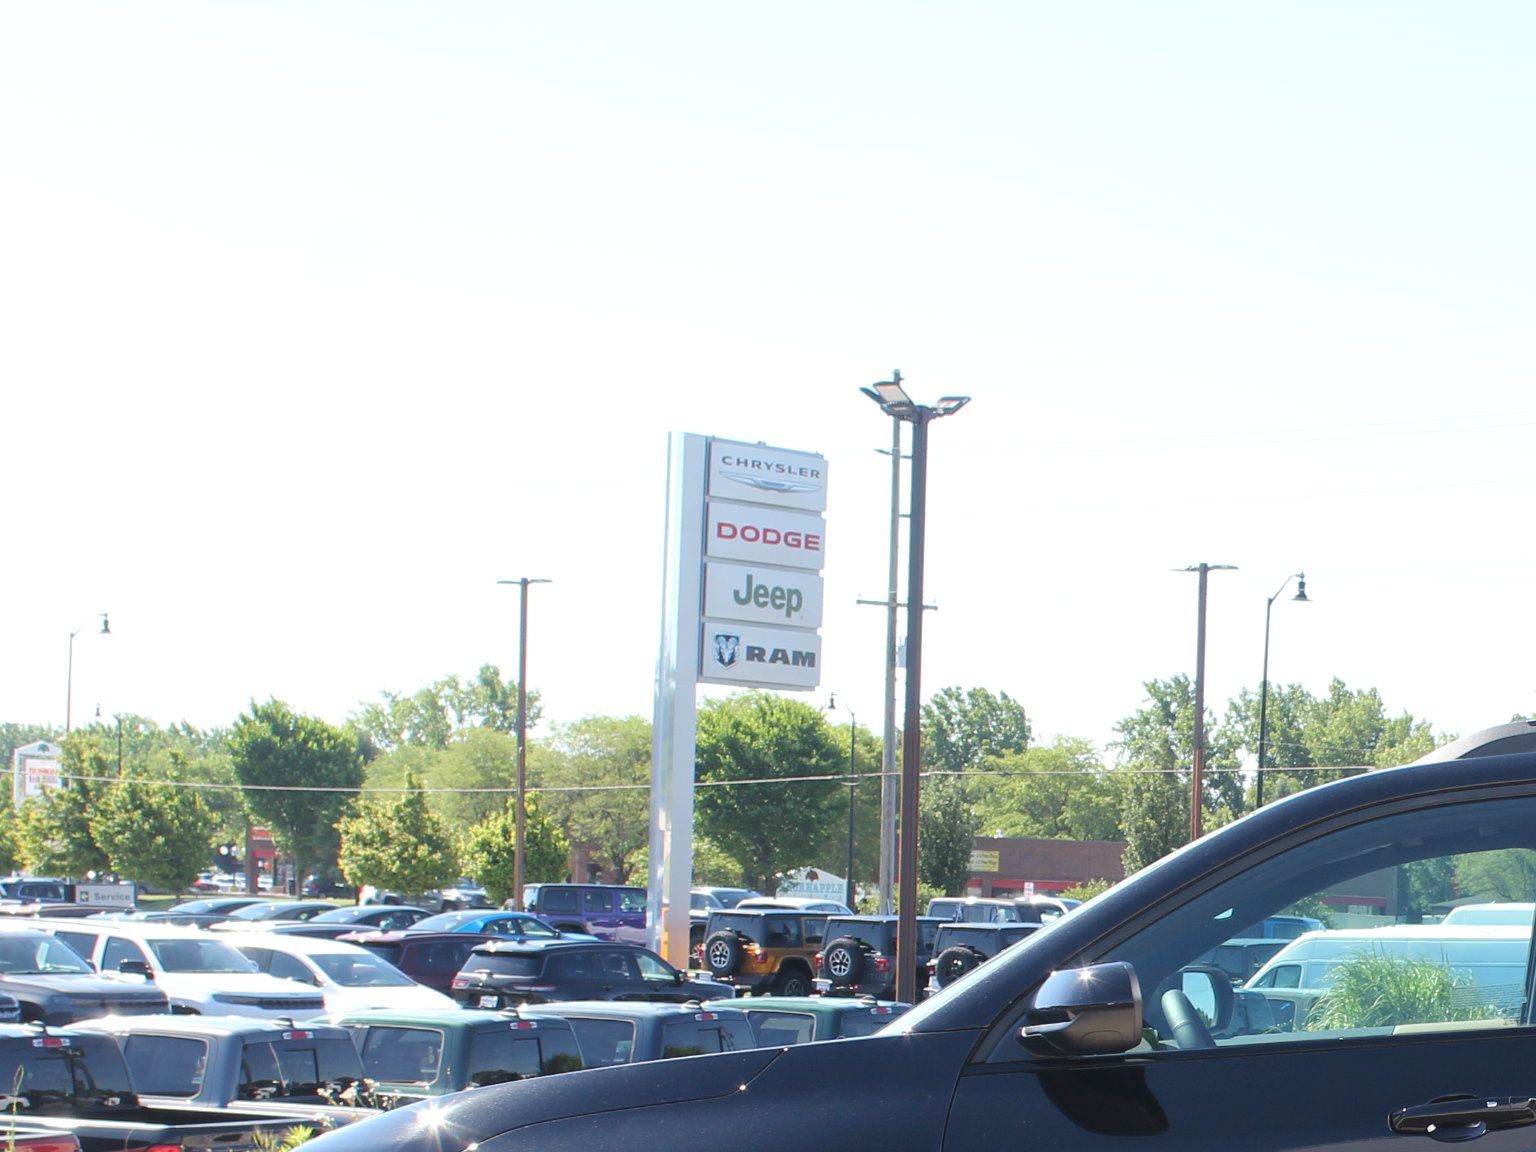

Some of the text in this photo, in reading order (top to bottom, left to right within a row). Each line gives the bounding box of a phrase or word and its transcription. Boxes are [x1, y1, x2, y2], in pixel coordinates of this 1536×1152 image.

[721, 455, 821, 479] CHRYSLER
[716, 522, 820, 551] DODGE
[733, 574, 803, 618] Jeep
[745, 645, 816, 668] RAM
[94, 892, 130, 901] Service
